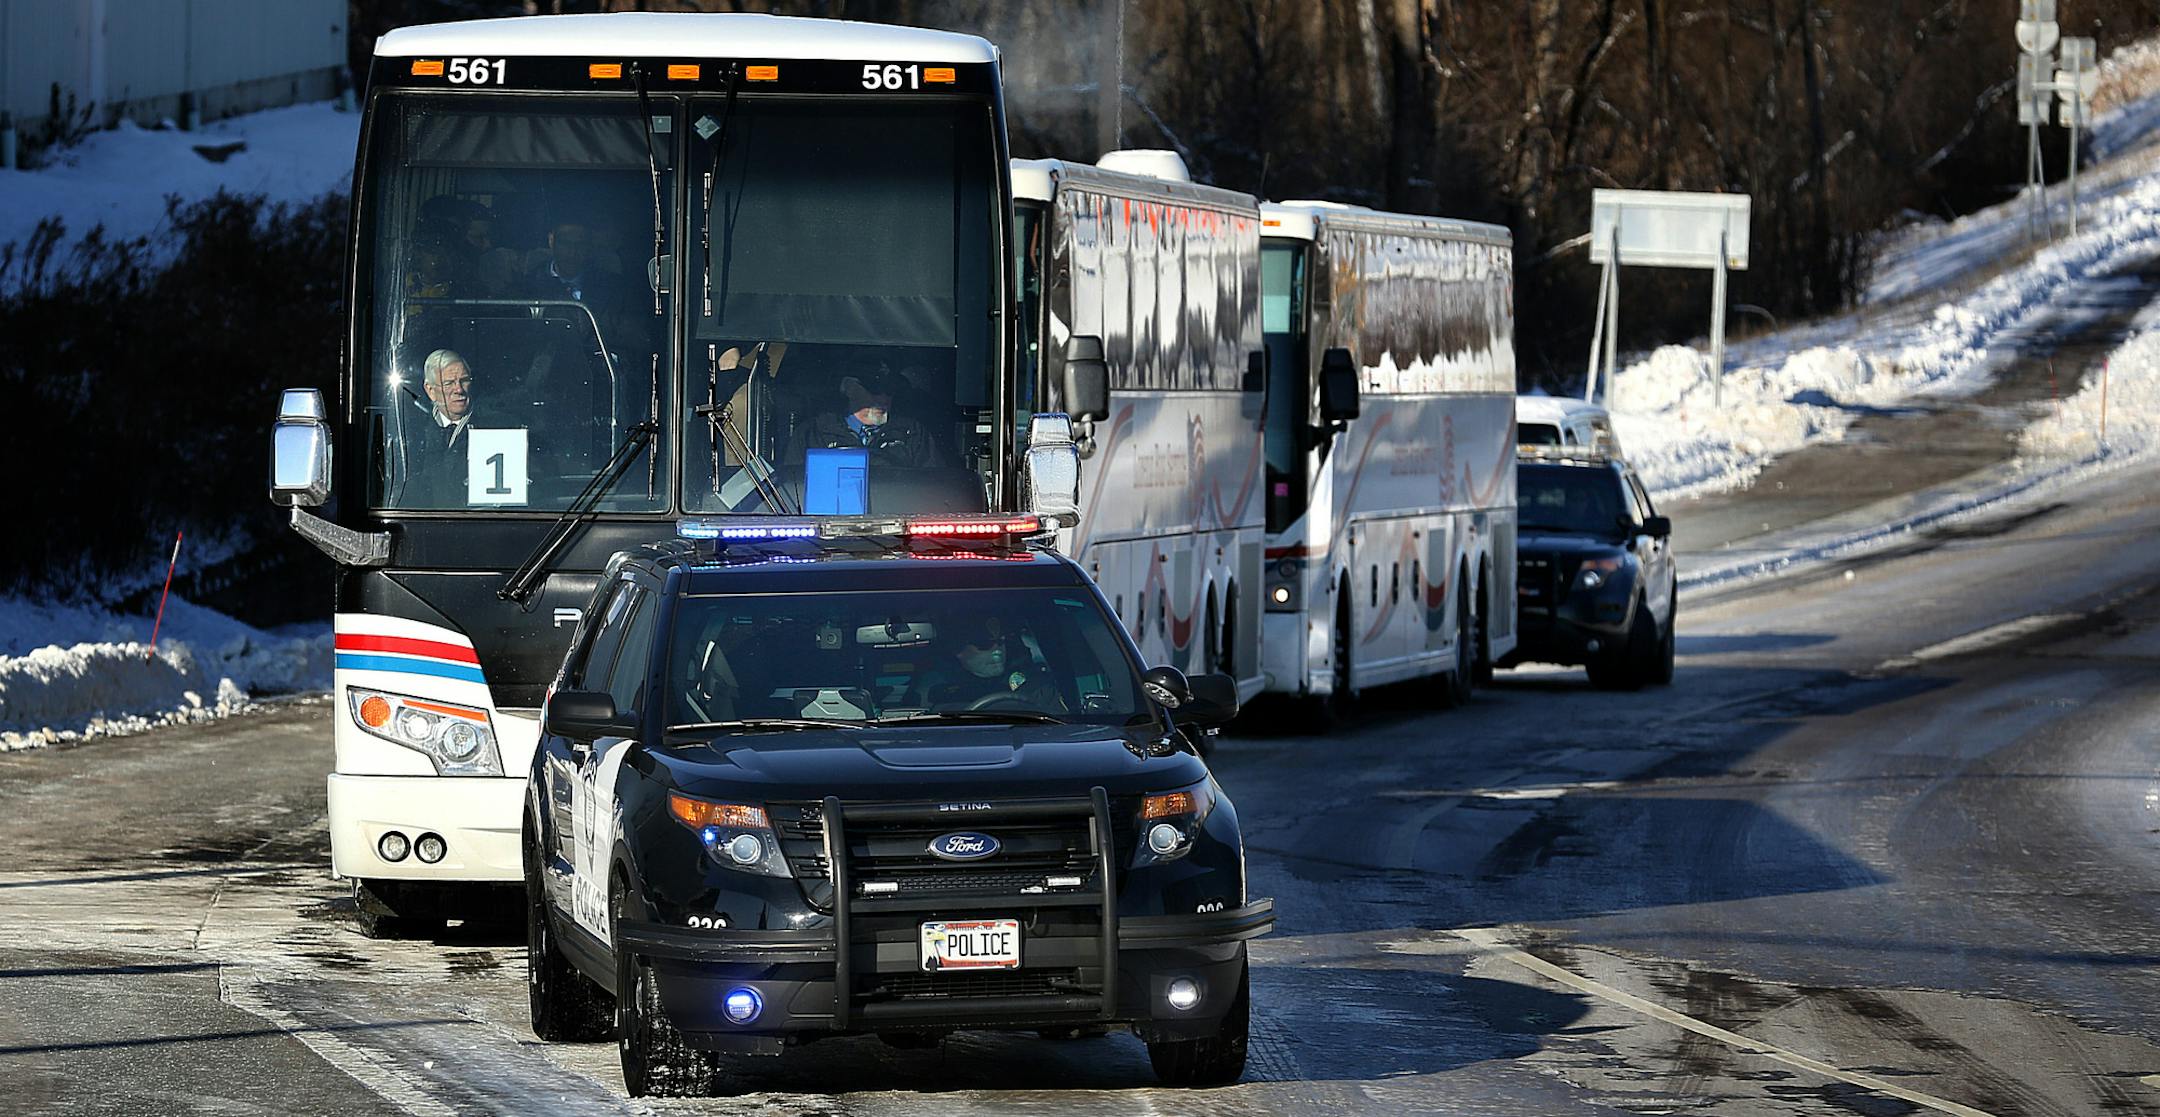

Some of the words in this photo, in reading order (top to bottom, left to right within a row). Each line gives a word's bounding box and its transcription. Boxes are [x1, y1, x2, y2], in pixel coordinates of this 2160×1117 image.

[448, 58, 506, 85] 561
[862, 64, 919, 89] 561
[486, 453, 511, 494] 1
[939, 803, 992, 811] SETINA
[945, 836, 985, 853] Ford
[576, 875, 607, 935] POLICE
[948, 932, 1011, 957] POLICE
